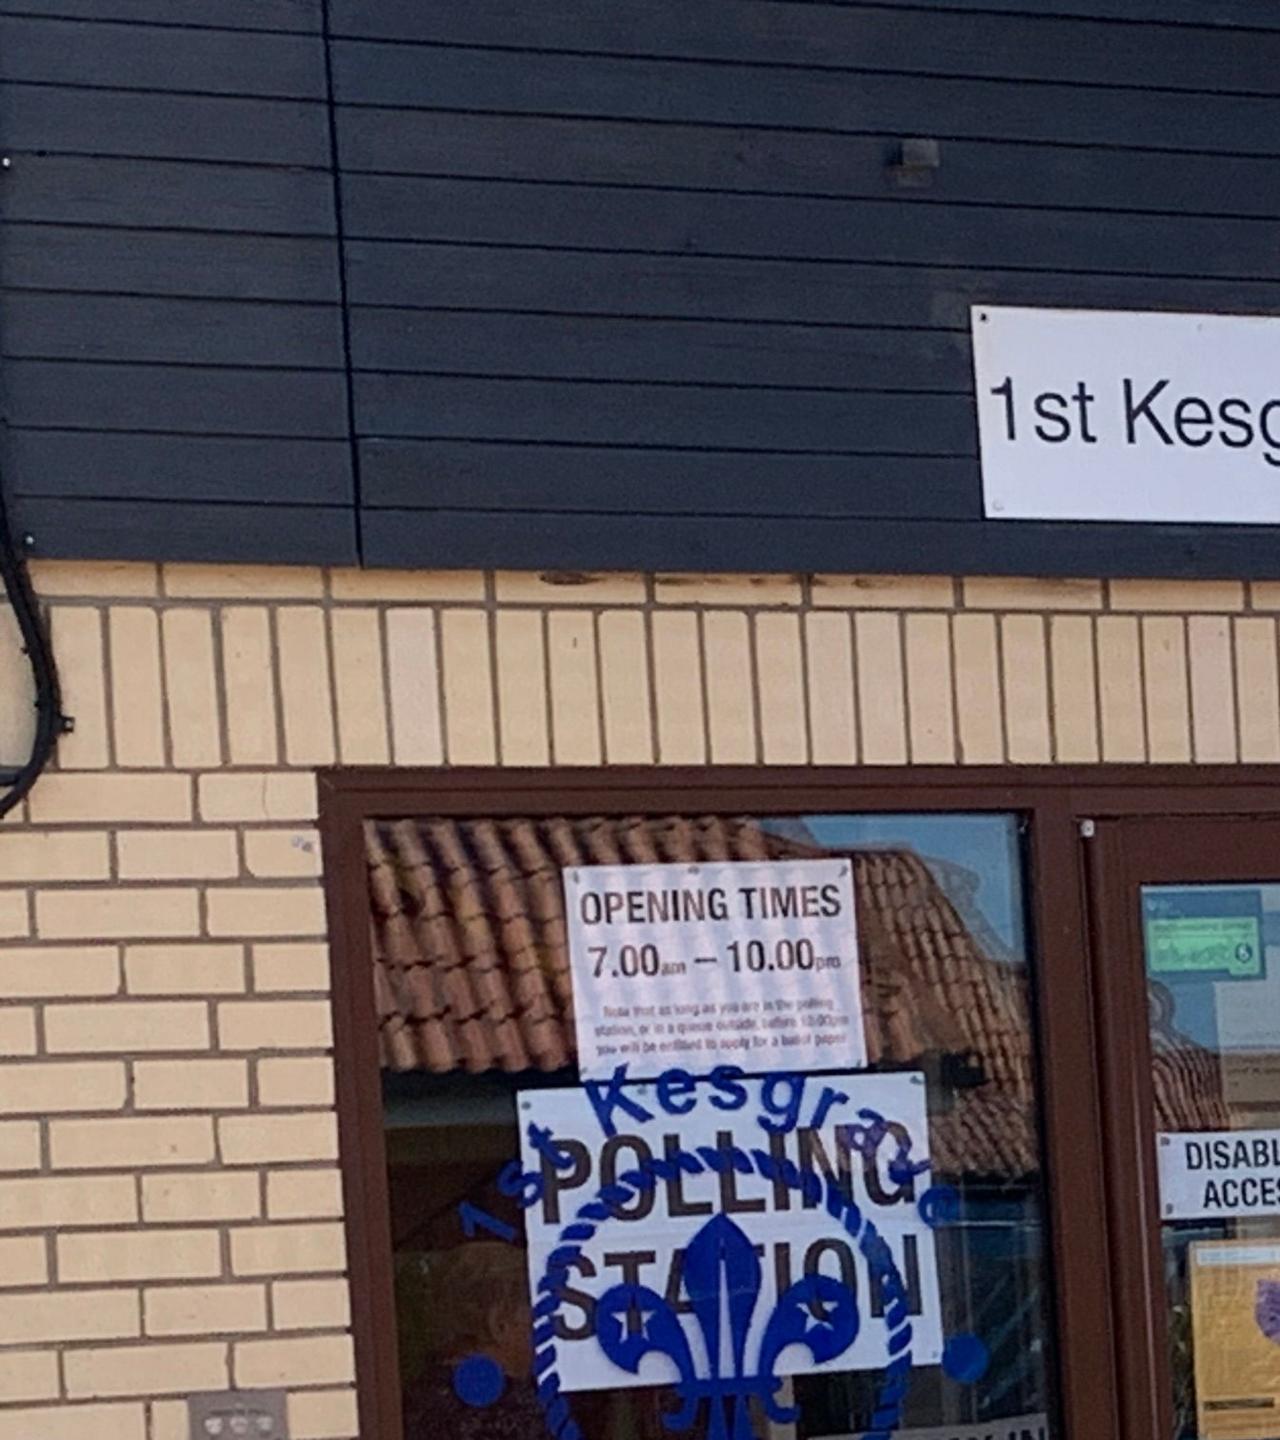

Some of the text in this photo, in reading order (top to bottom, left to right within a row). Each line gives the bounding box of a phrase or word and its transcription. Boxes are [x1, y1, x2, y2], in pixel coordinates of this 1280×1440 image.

[990, 375, 1097, 444] 1st
[580, 884, 842, 926] OPENING TIMES
